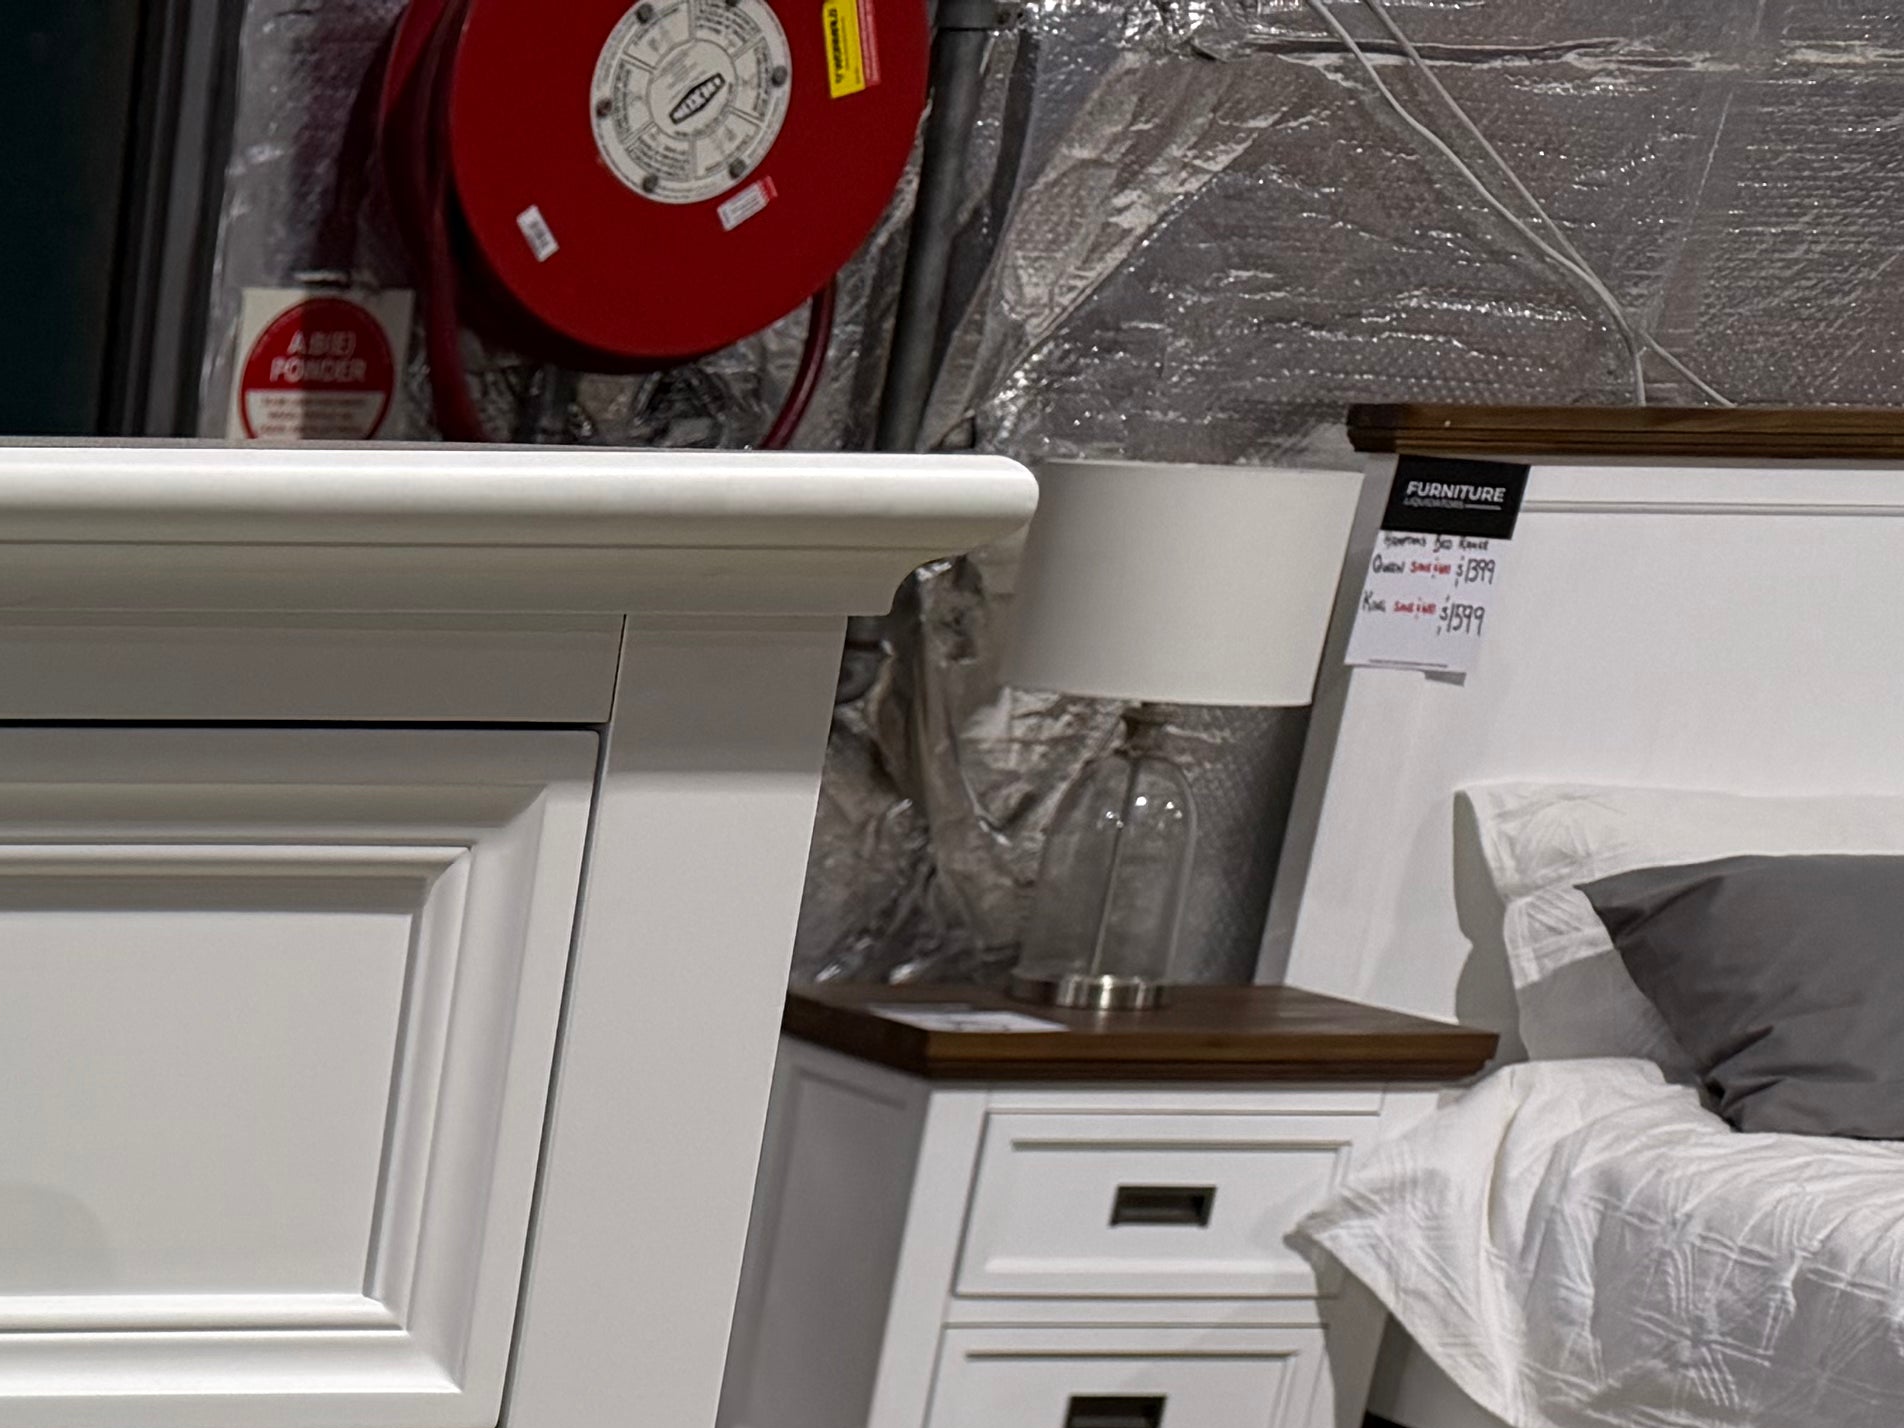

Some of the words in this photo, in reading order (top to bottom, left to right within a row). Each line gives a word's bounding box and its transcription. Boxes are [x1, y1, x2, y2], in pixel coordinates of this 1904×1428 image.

[269, 356, 367, 383] POWDER
[1406, 480, 1507, 503] FURNITURE
[1455, 555, 1495, 588] $1399
[1437, 595, 1485, 636] $1599
